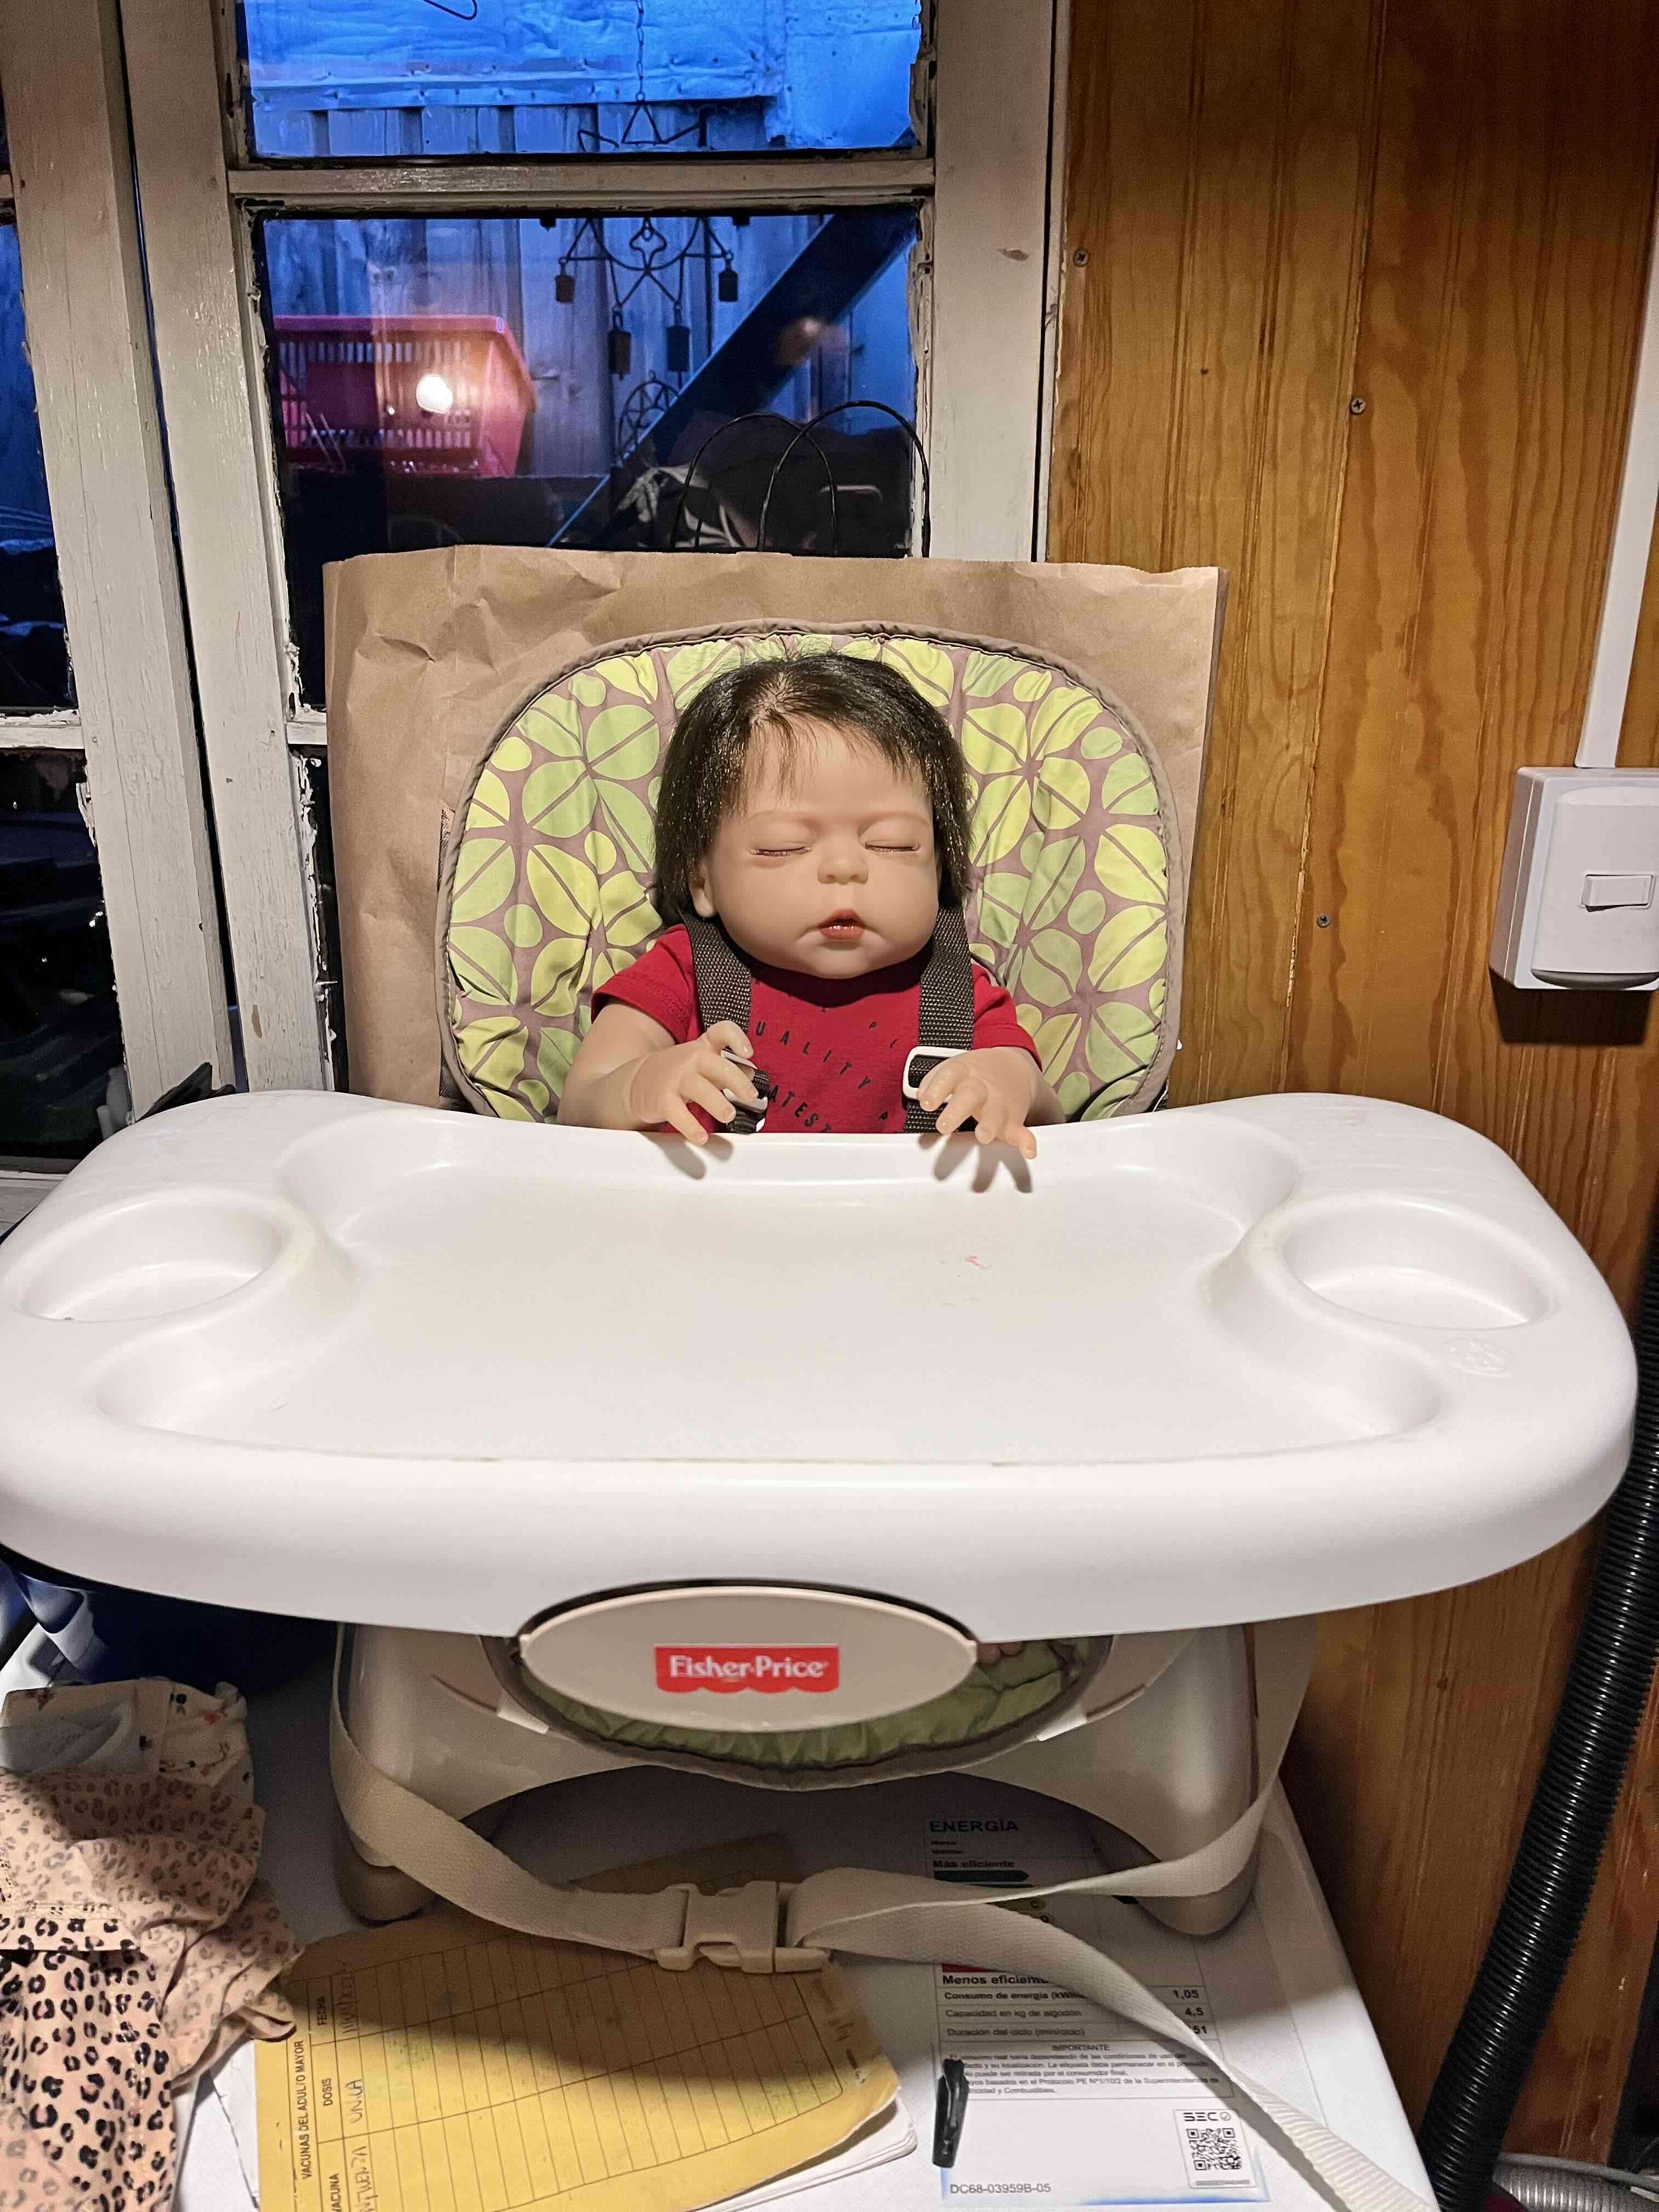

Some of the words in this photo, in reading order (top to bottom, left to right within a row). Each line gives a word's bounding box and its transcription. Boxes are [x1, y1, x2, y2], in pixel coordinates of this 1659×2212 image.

[669, 1655, 825, 1678] Fisher-Price
[943, 1975, 987, 1984] Menos
[1173, 1990, 1199, 1999] 1,05
[946, 2010, 997, 2018] Capacidad
[1014, 2010, 1026, 2018] kg
[294, 2040, 306, 2073] MAYOR
[321, 2078, 334, 2106] DOSIS
[298, 2112, 309, 2131] DEL
[1183, 2112, 1218, 2121] SEC
[299, 2134, 312, 2180] VACUNAS
[950, 2183, 1052, 2194] DC68-03959B-05
